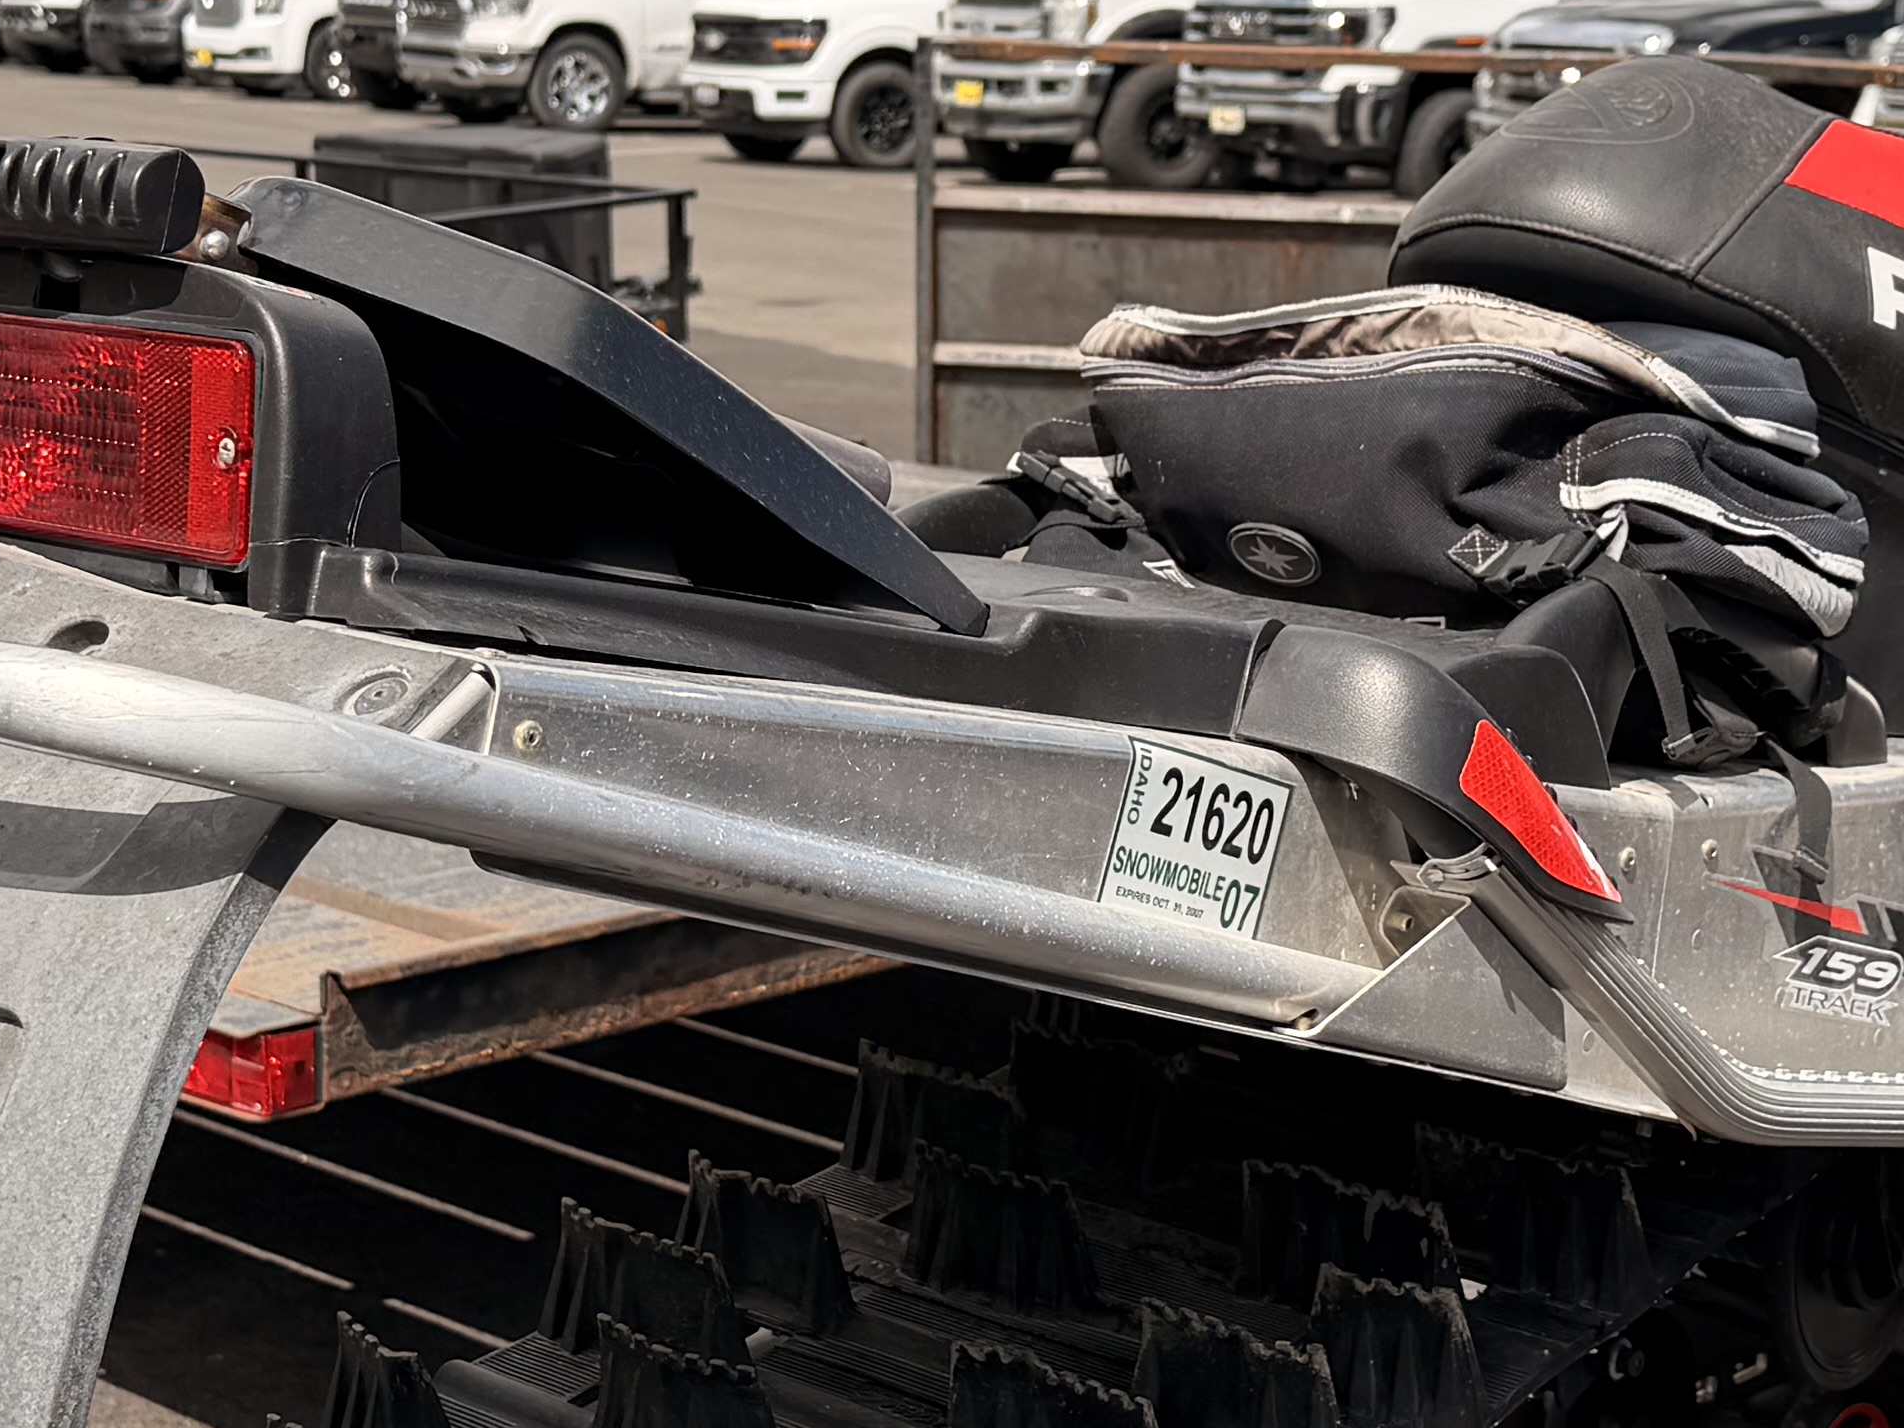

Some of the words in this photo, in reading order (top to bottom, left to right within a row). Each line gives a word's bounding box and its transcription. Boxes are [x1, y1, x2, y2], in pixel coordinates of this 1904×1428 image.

[1127, 747, 1153, 825] IDAHO
[1150, 767, 1274, 864] 21620
[1112, 845, 1226, 902] SNOWMOBILE
[1116, 885, 1151, 904] EXPIRES
[1220, 879, 1261, 932] 07
[1800, 946, 1899, 990] 159
[1792, 986, 1887, 1022] TRACK
